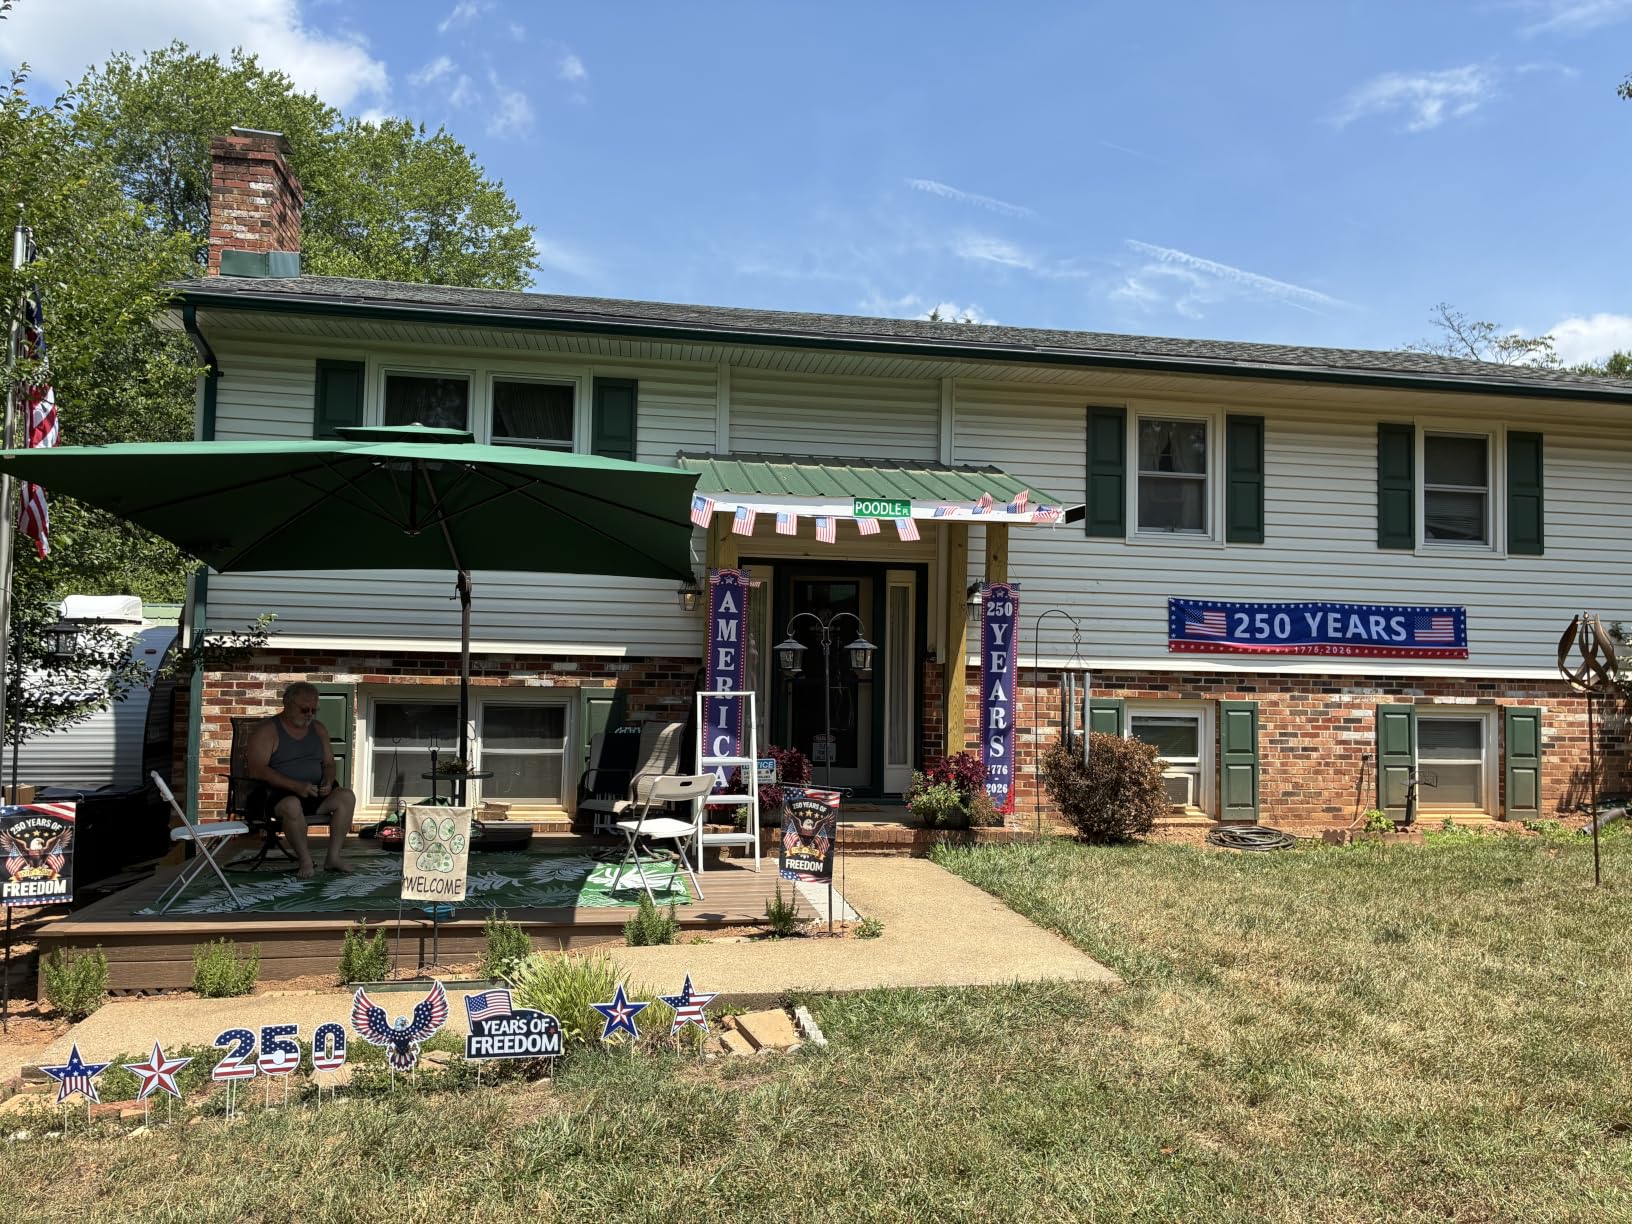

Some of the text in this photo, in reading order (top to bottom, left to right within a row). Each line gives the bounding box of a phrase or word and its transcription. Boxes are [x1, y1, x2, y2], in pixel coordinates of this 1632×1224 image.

[855, 501, 902, 515] POODLE
[986, 601, 1013, 617] 250
[1233, 611, 1407, 641] 250 YEARS
[713, 590, 738, 788] AMERICA
[989, 623, 1008, 758] YEARS
[986, 783, 1008, 793] 2026
[802, 801, 820, 810] YEARS
[10, 818, 63, 835] 250 YEARS OF
[785, 858, 824, 873] FREEDOM
[3, 879, 67, 897] FREEDOM
[403, 876, 462, 895] WELCOME
[481, 1018, 550, 1035] YEARS OF
[212, 1021, 346, 1080] 250
[471, 1034, 558, 1055] FREEDOM
